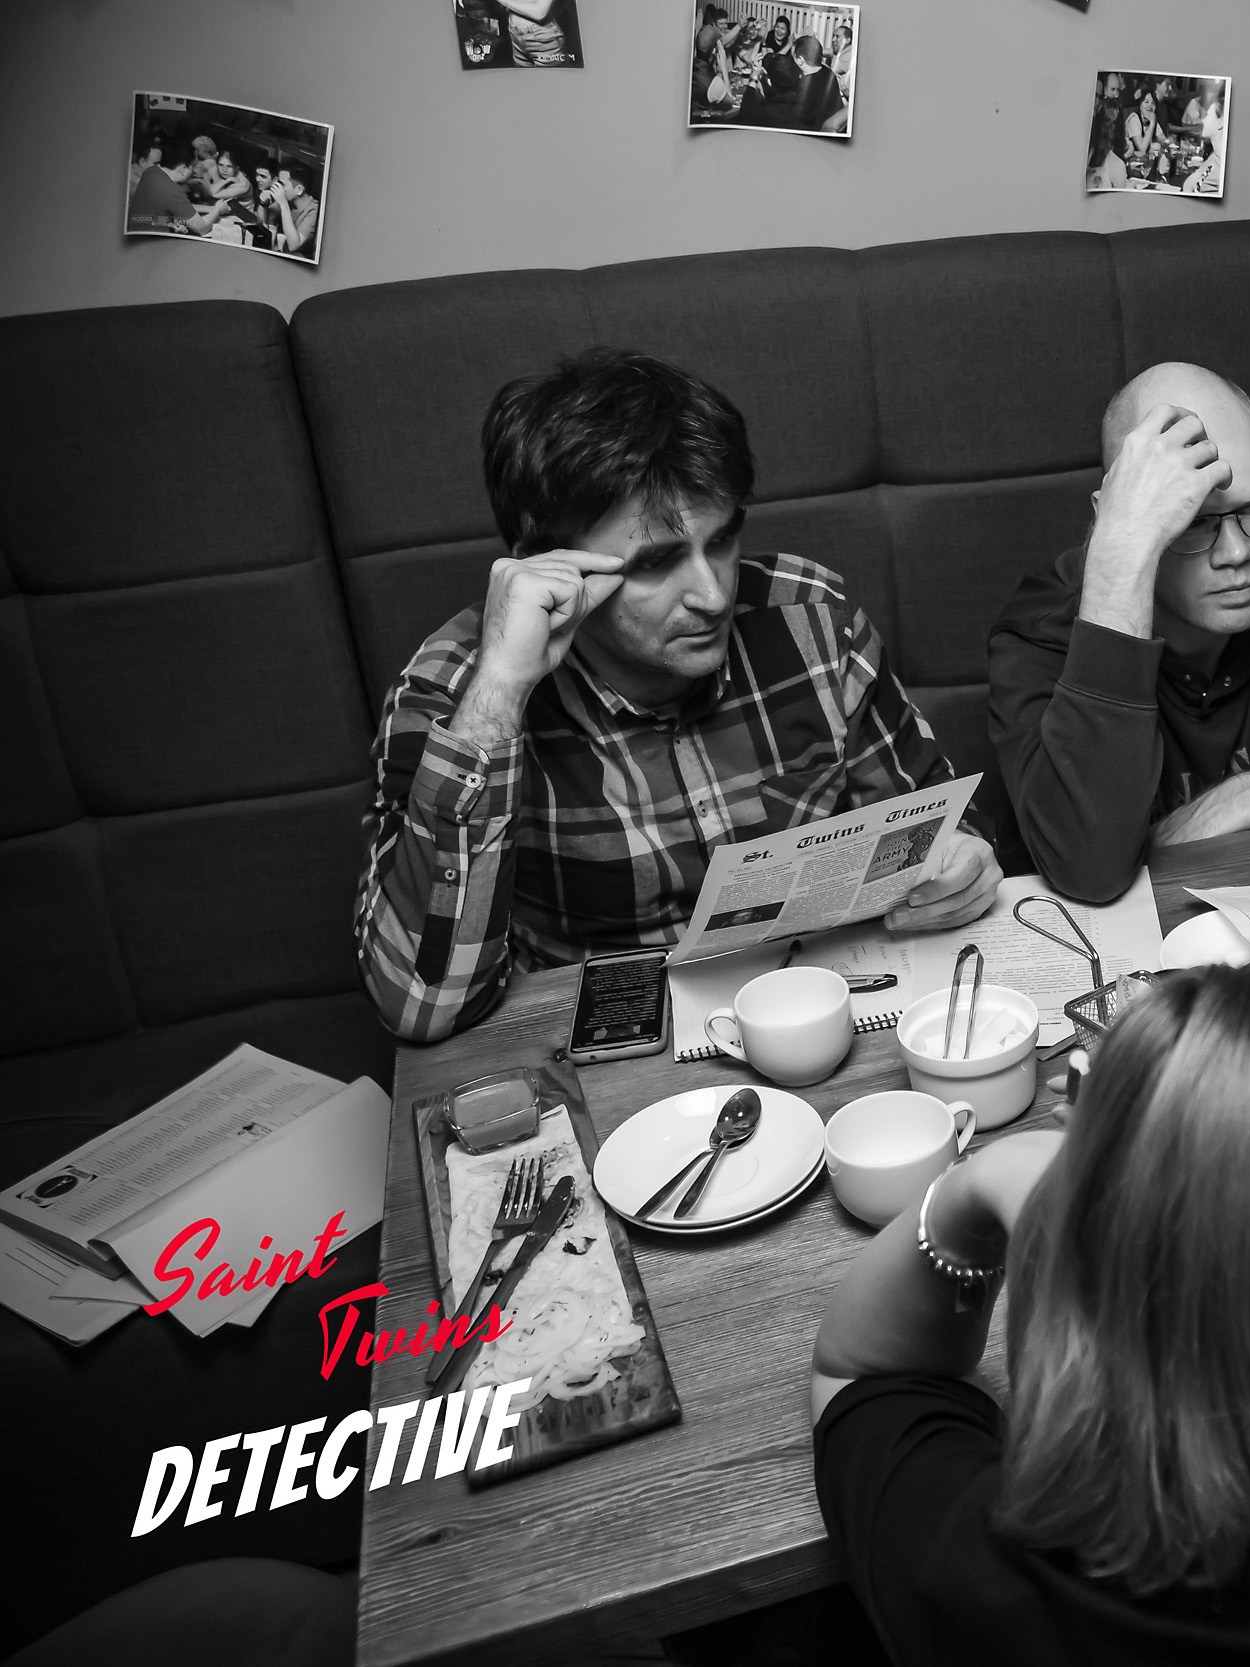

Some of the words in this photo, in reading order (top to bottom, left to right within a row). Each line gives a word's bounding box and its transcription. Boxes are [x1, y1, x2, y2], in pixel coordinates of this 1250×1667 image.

[741, 850, 774, 865] St.
[796, 824, 865, 849] Twins
[885, 799, 948, 823] Times
[872, 845, 913, 864] ARMY
